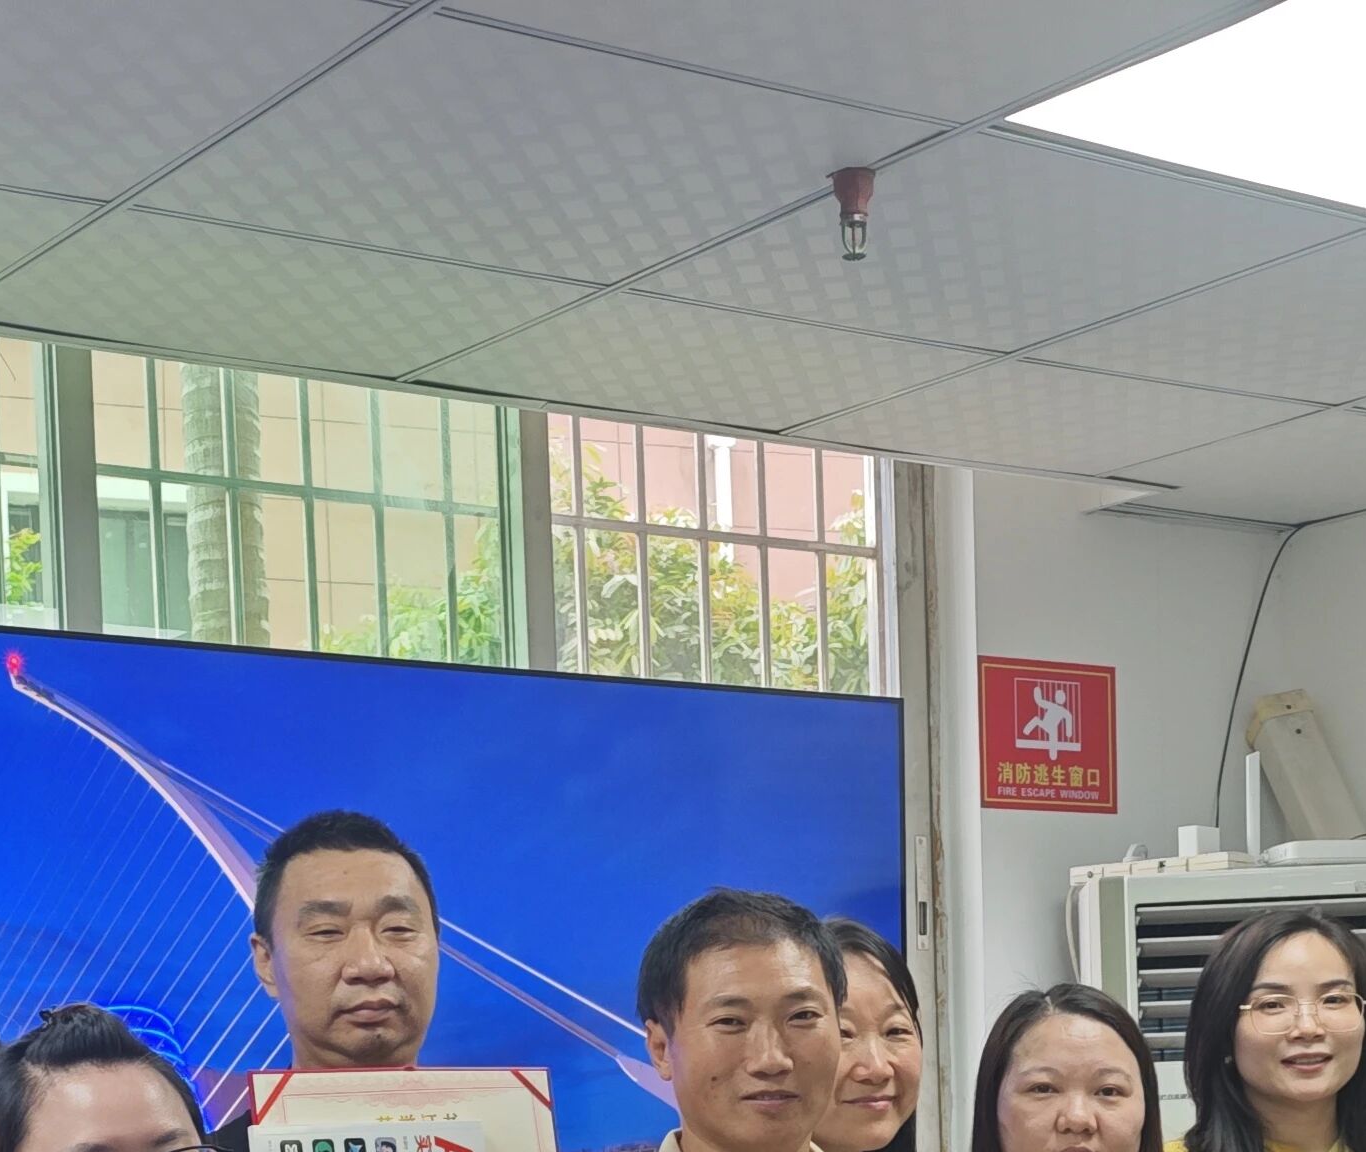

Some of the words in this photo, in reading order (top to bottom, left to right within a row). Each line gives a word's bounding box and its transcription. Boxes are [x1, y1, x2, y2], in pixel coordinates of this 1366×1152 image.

[997, 761, 1100, 787] 消防逃生窗口
[997, 786, 1017, 797] FIRE
[1021, 787, 1056, 799] ESCAPE
[1060, 789, 1100, 800] WINDOW
